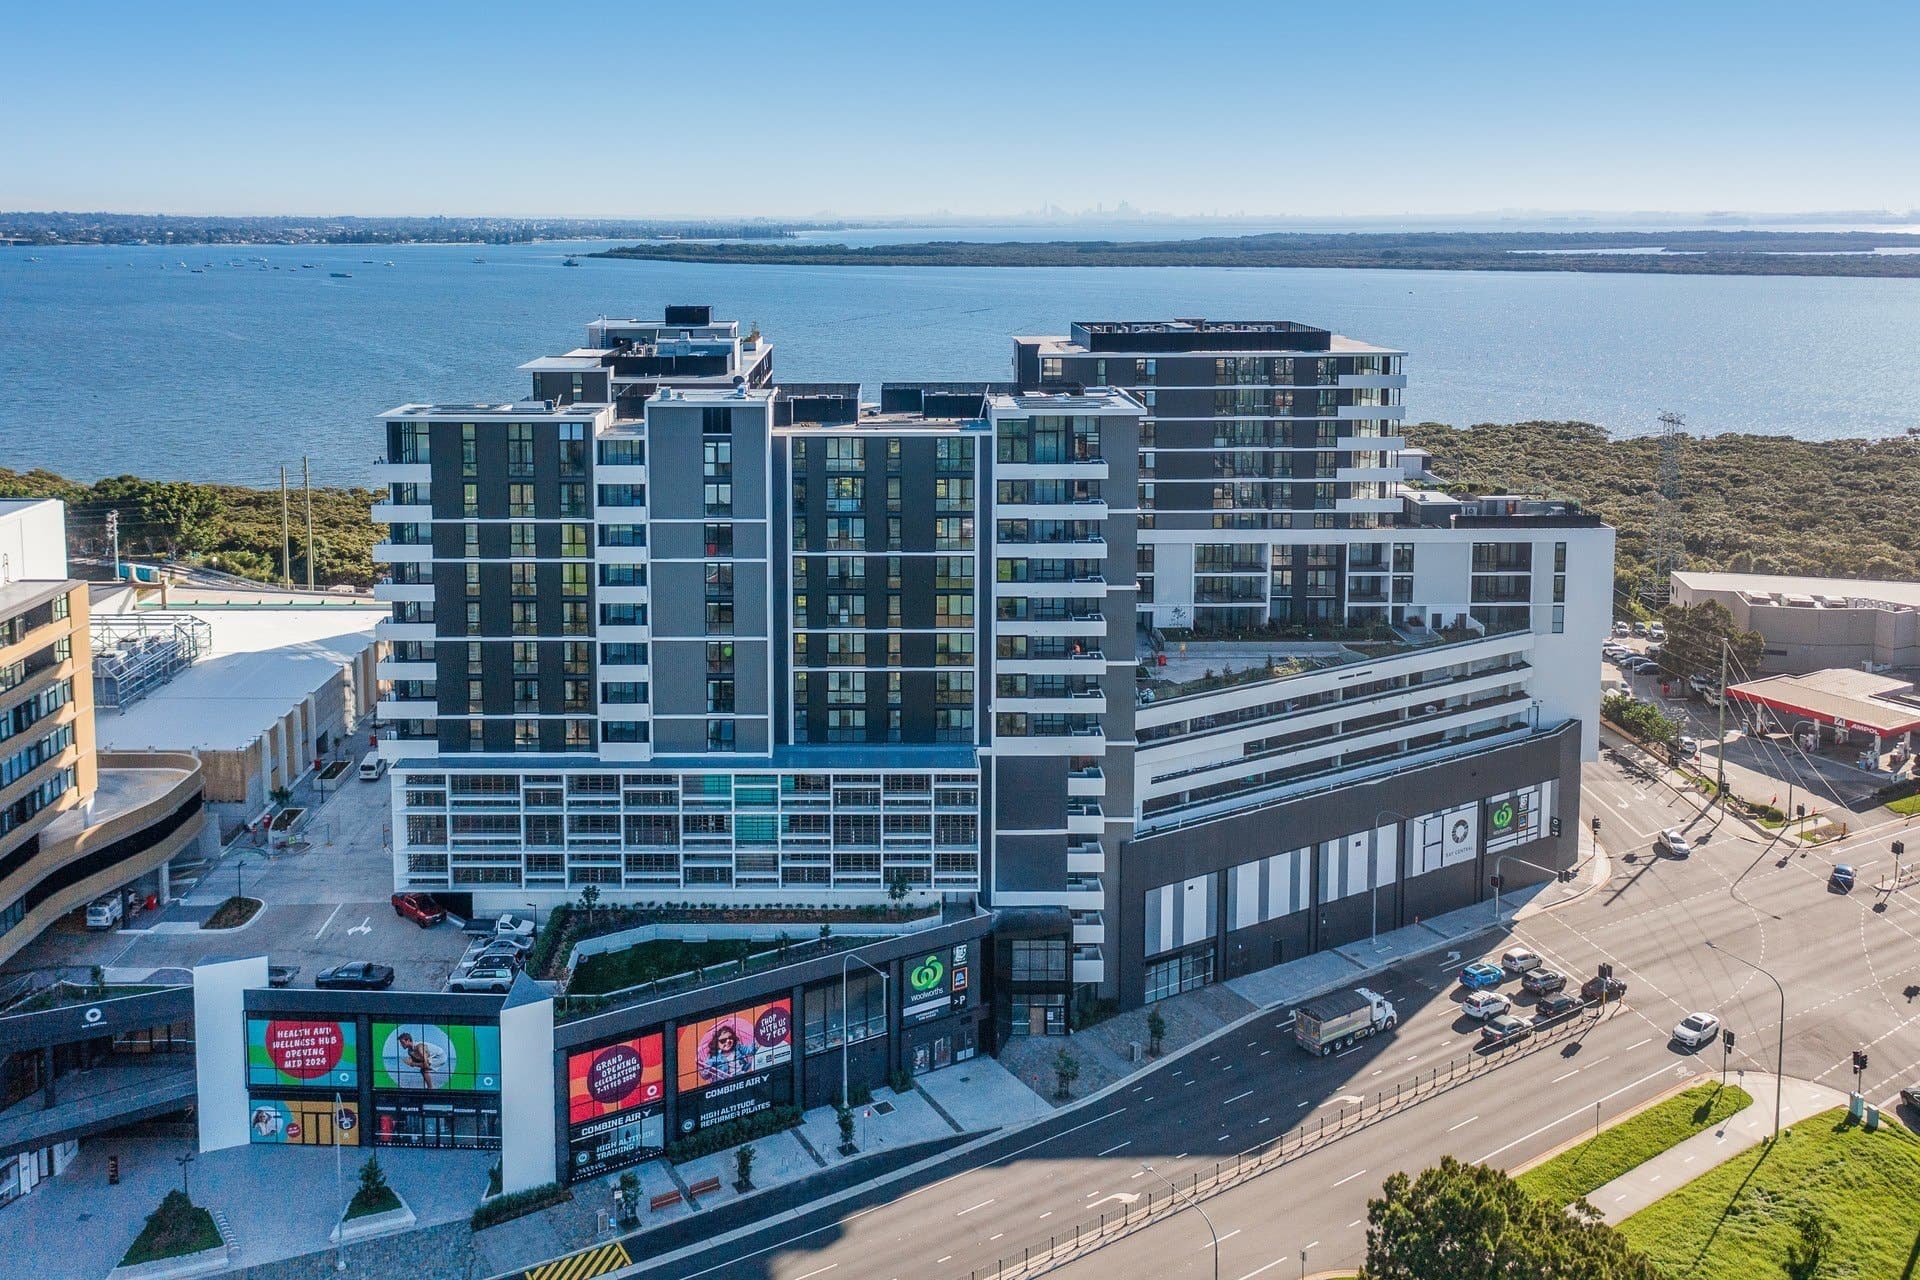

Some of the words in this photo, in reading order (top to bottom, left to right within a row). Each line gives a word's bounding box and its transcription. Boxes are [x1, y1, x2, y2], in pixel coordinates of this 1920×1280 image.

[1851, 723, 1879, 735] AMPOL
[761, 1013, 777, 1027] SHOP
[778, 1017, 786, 1027] US
[277, 1027, 311, 1038] HEALTH
[313, 1026, 332, 1035] AND
[766, 1032, 771, 1041] 7
[272, 1038, 316, 1049] WELLNESS
[318, 1036, 337, 1045] HUB
[285, 1047, 325, 1058] OPENING
[284, 1060, 303, 1068] MID
[305, 1057, 327, 1066] 2024
[595, 1054, 623, 1071] GRAND
[601, 1056, 637, 1078] OPENING
[594, 1063, 641, 1088] CELEBRATIONS
[622, 1072, 637, 1083] 2024
[705, 1081, 744, 1099] COMBINE
[745, 1076, 761, 1087] AIR
[700, 1109, 720, 1121] HIGH
[720, 1099, 756, 1115] ALTITUDE
[700, 1110, 741, 1128] REFORMER
[741, 1101, 771, 1117] PILATES
[581, 1117, 624, 1136] COMBINE
[624, 1112, 641, 1123] AIR
[596, 1141, 617, 1153] HIGH
[596, 1143, 634, 1161] TRAINING
